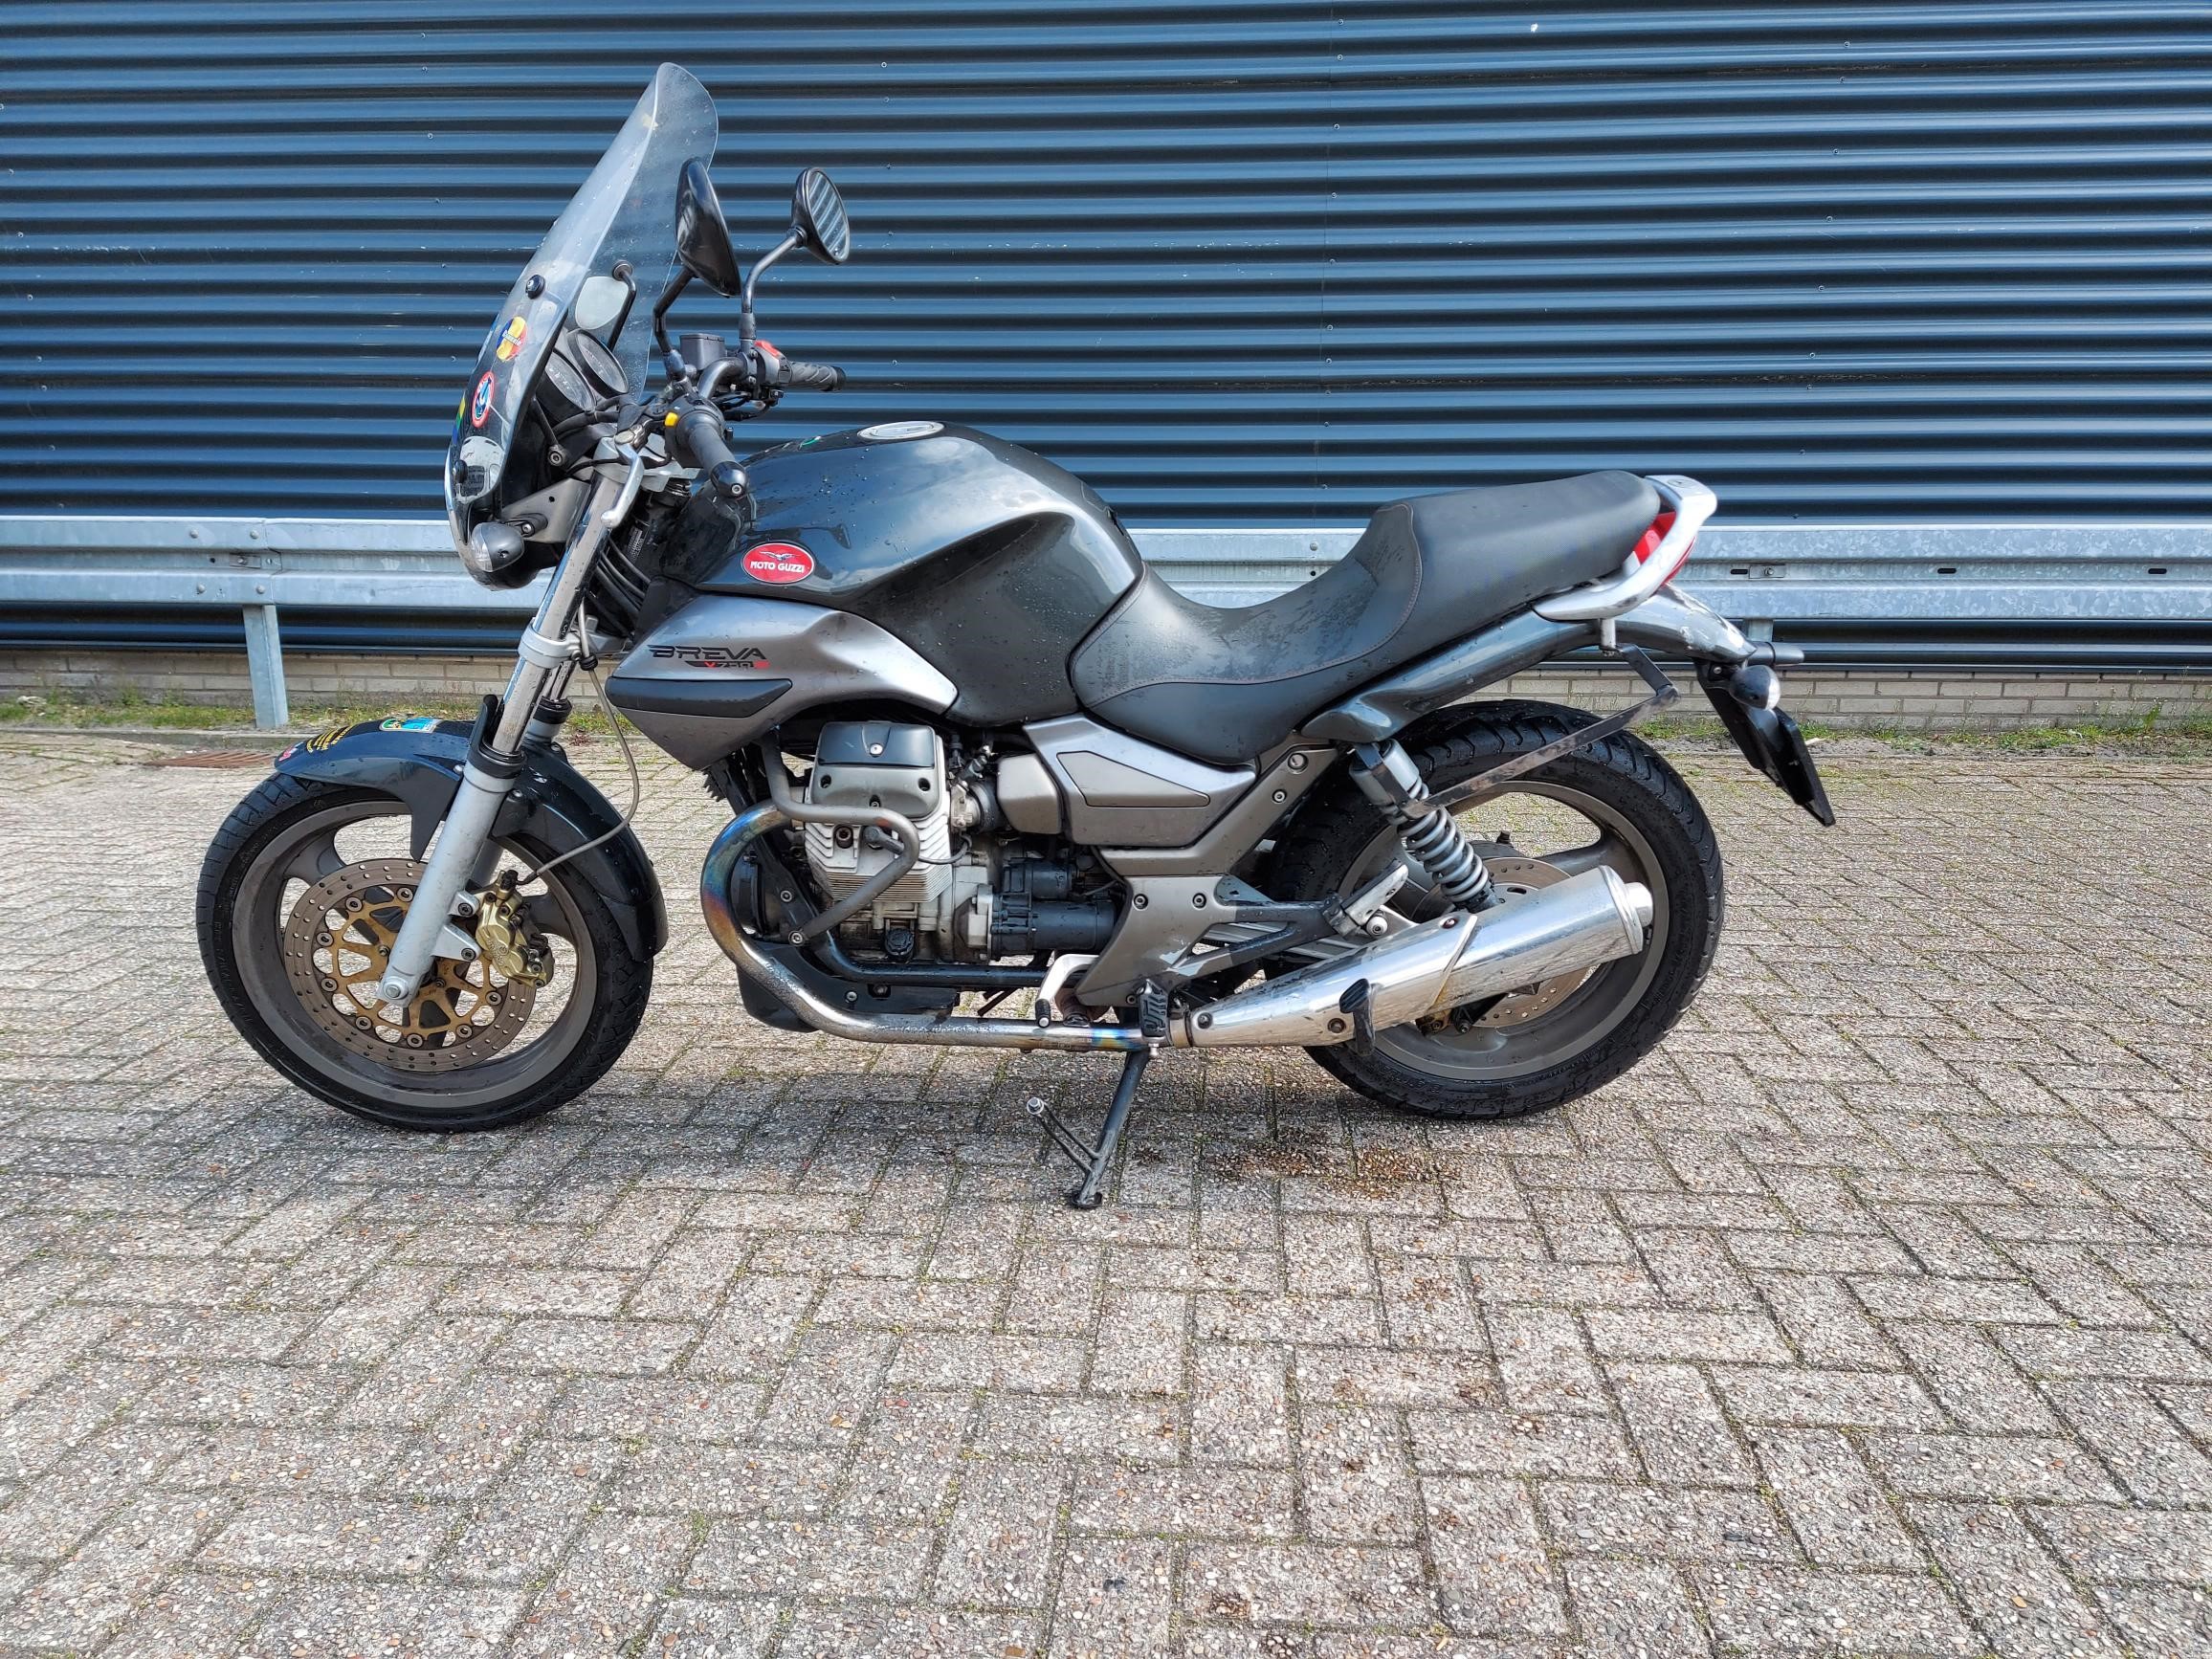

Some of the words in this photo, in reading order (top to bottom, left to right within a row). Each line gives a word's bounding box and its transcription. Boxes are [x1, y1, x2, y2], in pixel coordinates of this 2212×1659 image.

[750, 561, 775, 570] MOTO
[778, 564, 806, 573] GUZZI
[647, 645, 766, 660] BREVA
